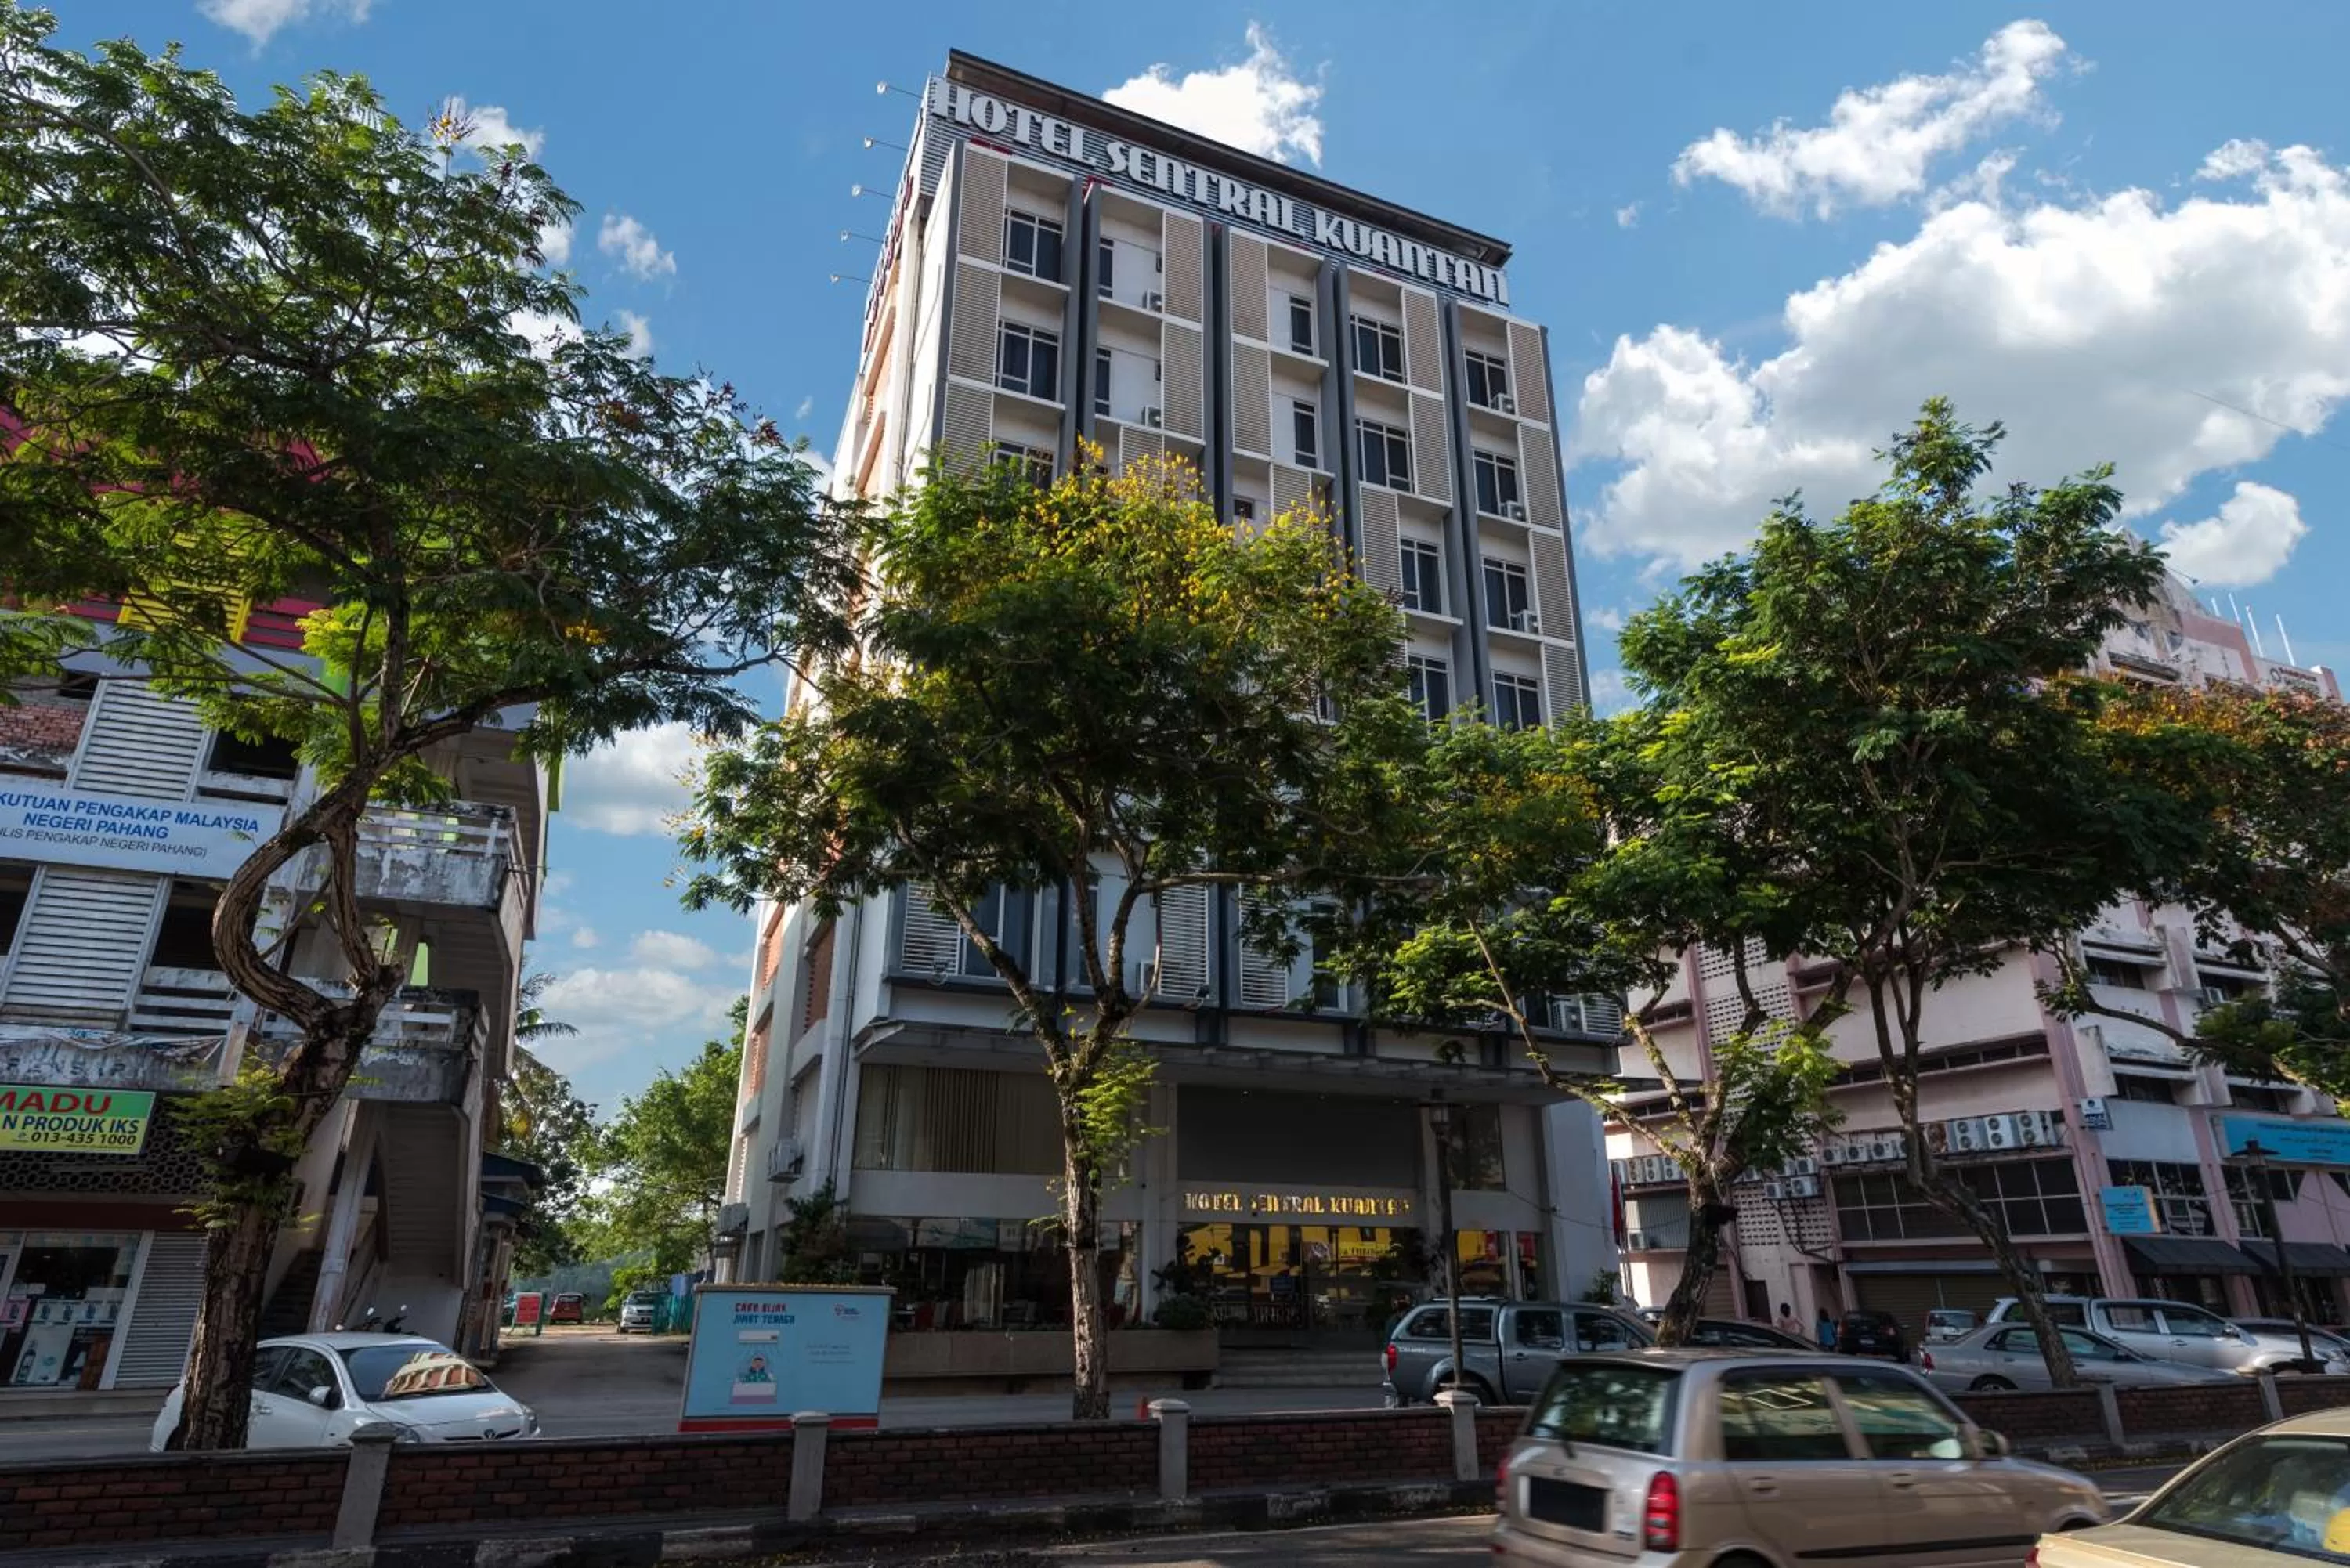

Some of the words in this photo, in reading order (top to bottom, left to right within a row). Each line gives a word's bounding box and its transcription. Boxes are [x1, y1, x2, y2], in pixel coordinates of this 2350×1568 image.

[931, 77, 1096, 167] HOTEL
[1107, 141, 1304, 237] SENTRAL
[1314, 208, 1509, 306] KUANTAN
[23, 812, 92, 831] NEGERI
[96, 822, 169, 840] PAHANG
[75, 800, 172, 822] PENGAKAP
[175, 812, 258, 832] MALAYSIA
[26, 829, 98, 846] PENGAKAP
[100, 837, 152, 851] NEGERI
[152, 842, 207, 858] PAHANG)
[22, 1116, 106, 1133] PRODUK
[109, 1119, 139, 1134] IKS
[31, 1132, 94, 1143] 013-435
[101, 1134, 136, 1146] 1000
[1184, 1193, 1243, 1212] HOTEL
[1330, 1196, 1409, 1215] KUANTA
